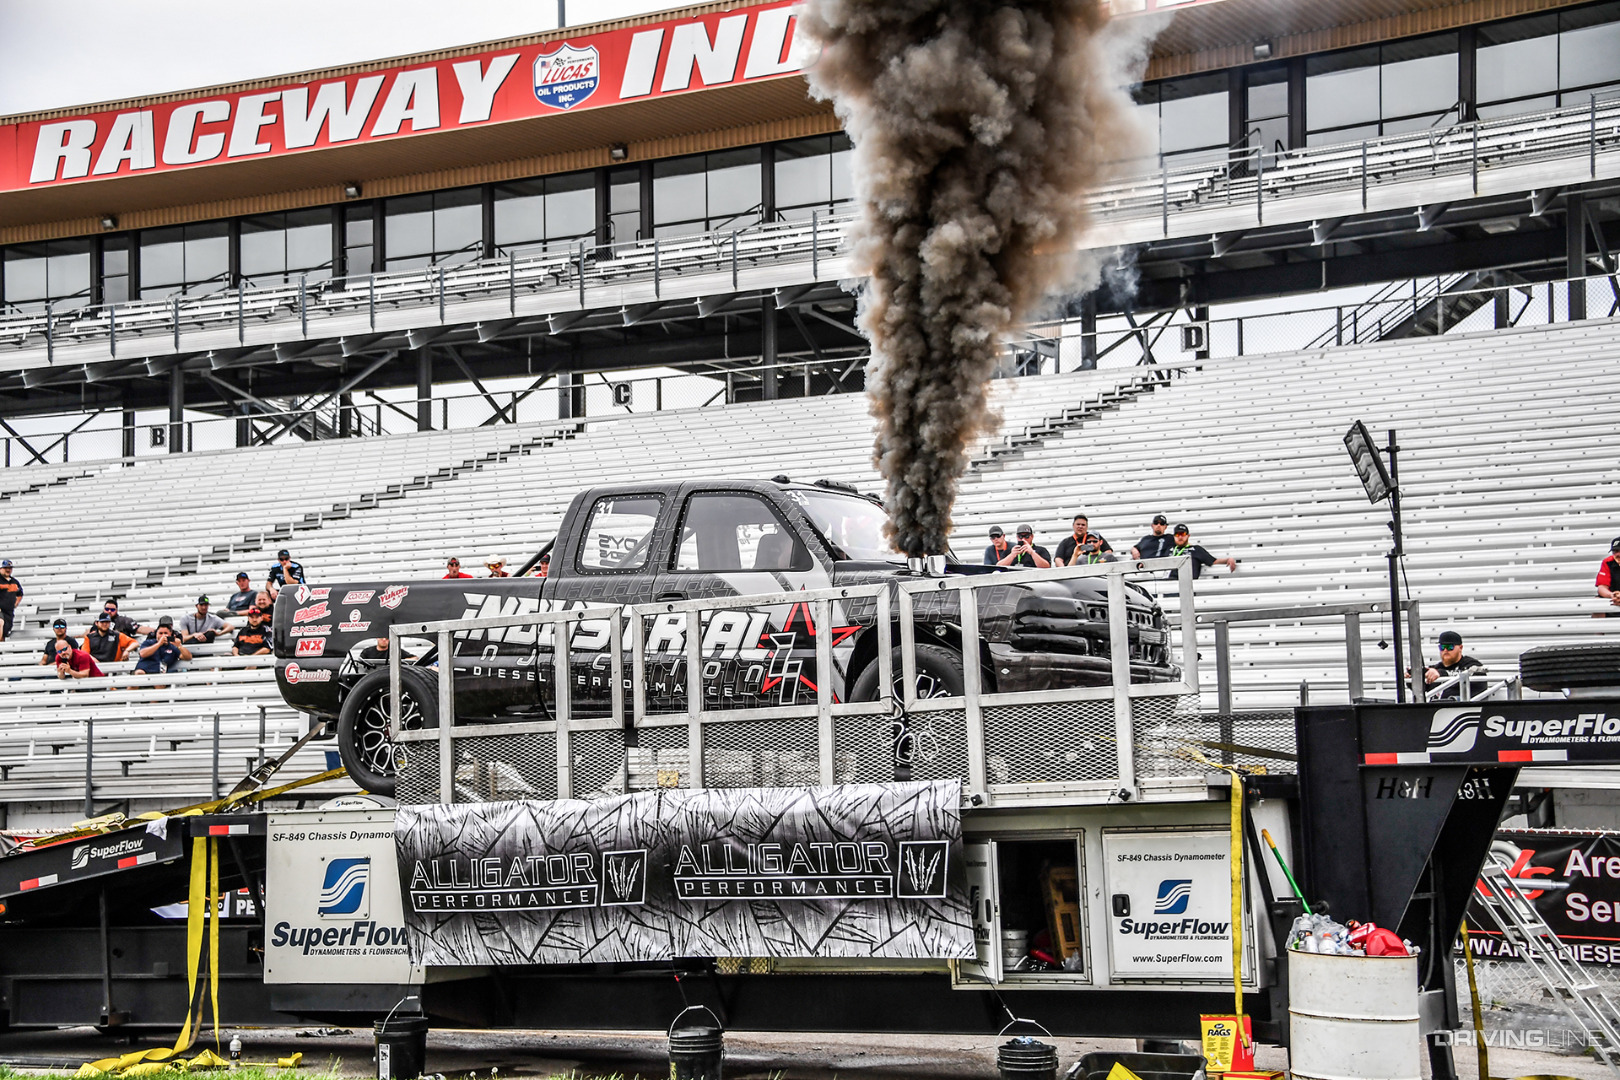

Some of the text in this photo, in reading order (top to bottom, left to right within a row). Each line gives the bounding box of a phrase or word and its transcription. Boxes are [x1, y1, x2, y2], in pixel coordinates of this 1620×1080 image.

[542, 62, 593, 84] LUCAS
[537, 80, 595, 96] OIL PRODUCTS
[558, 94, 575, 103] INC.
[29, 53, 521, 183] RACEWAY
[1184, 326, 1203, 350] D
[614, 383, 630, 405] C
[152, 427, 165, 446] B
[597, 501, 614, 515] 31
[380, 586, 408, 603] Yukon
[299, 640, 323, 652] NX
[473, 666, 547, 682] DIESEL
[272, 832, 306, 842] SF-849
[308, 831, 347, 841] Chassis
[90, 839, 144, 859] SuperFlow
[674, 841, 891, 875] ALLIGATOR
[1117, 854, 1142, 862] SF-849
[1174, 853, 1226, 863] Dynamometer
[410, 853, 597, 888] ALLIGATOR
[684, 880, 885, 895] PERFORMANCE
[418, 890, 589, 908] PERFORMANCE
[1119, 918, 1229, 940] SuperFlow
[271, 920, 408, 956] SuperFlow
[310, 948, 361, 956] DYNAMOMETERS
[1132, 953, 1223, 964] www.SuperFlow.com
[1208, 1029, 1231, 1037] RAGS
